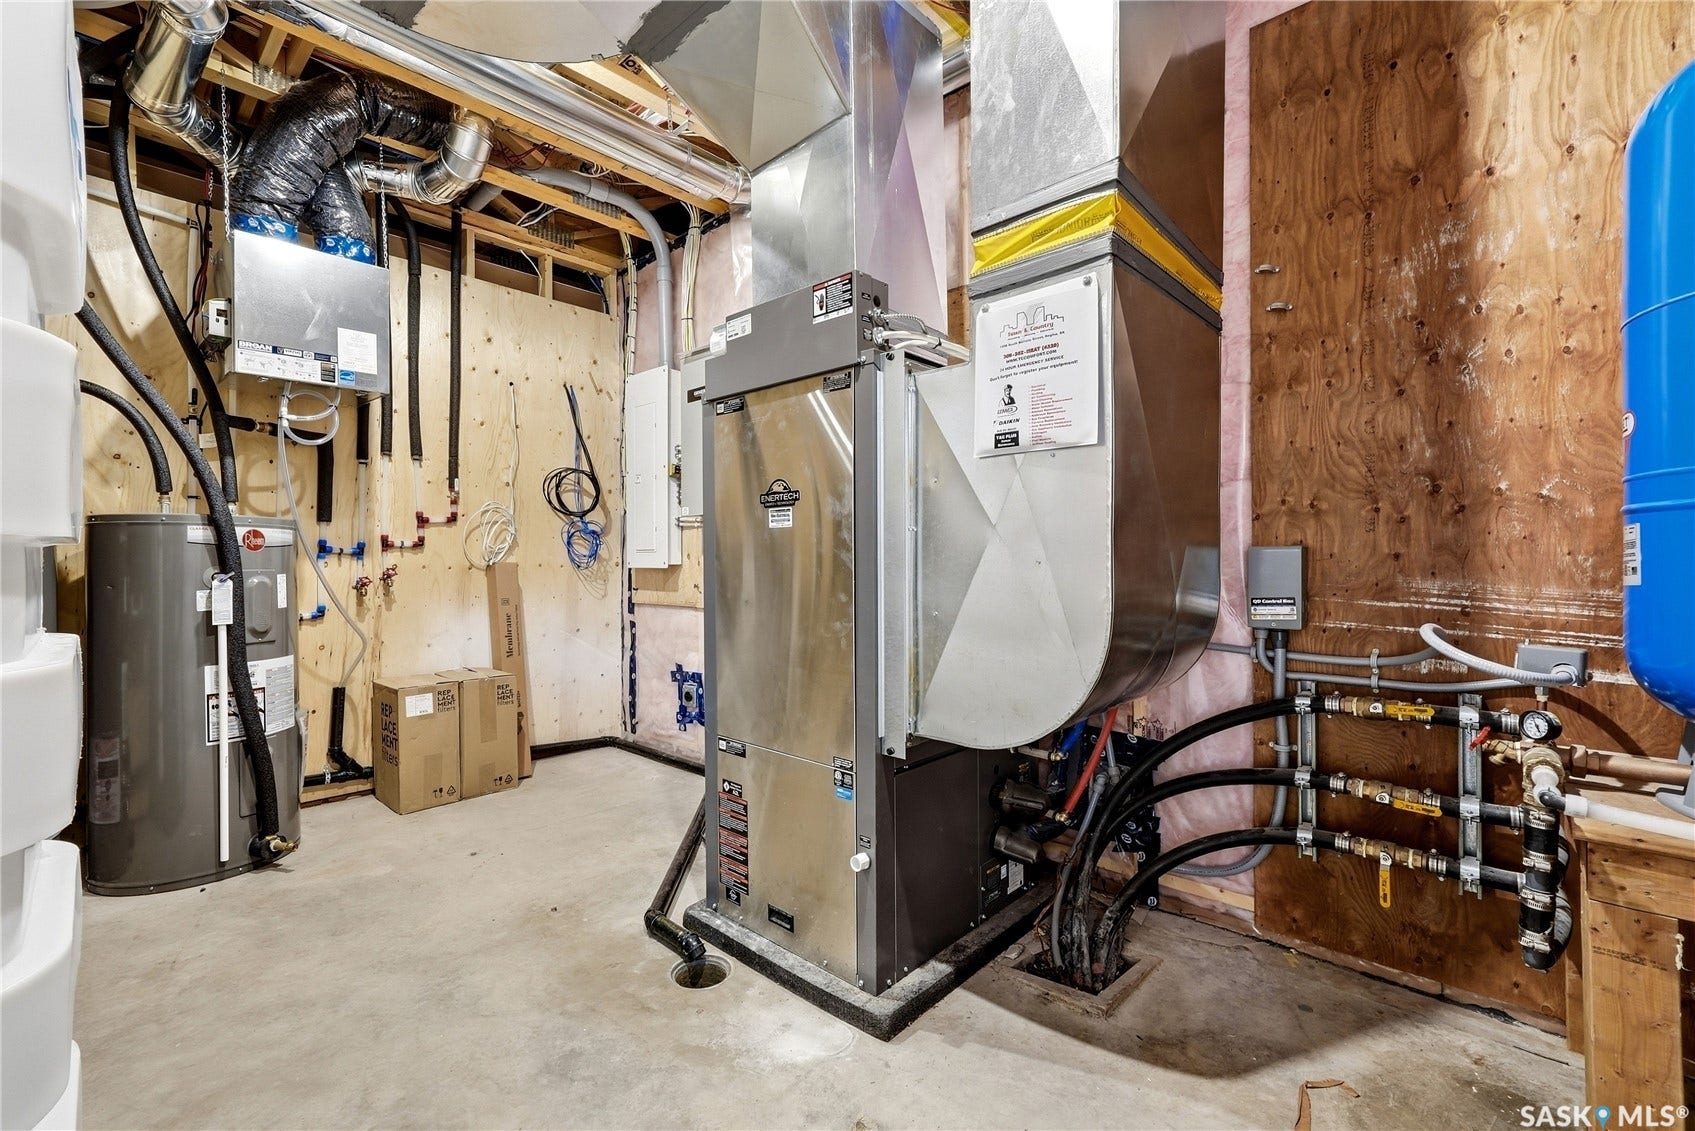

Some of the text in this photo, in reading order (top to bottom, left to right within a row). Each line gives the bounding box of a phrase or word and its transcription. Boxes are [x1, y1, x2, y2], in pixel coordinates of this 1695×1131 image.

[239, 340, 272, 351] BROAN
[761, 492, 799, 502] ENERTECH
[437, 694, 456, 702] LACE
[437, 700, 456, 708] MENT
[381, 702, 393, 718] REP
[381, 717, 396, 736] LACE
[381, 732, 398, 751] MENT
